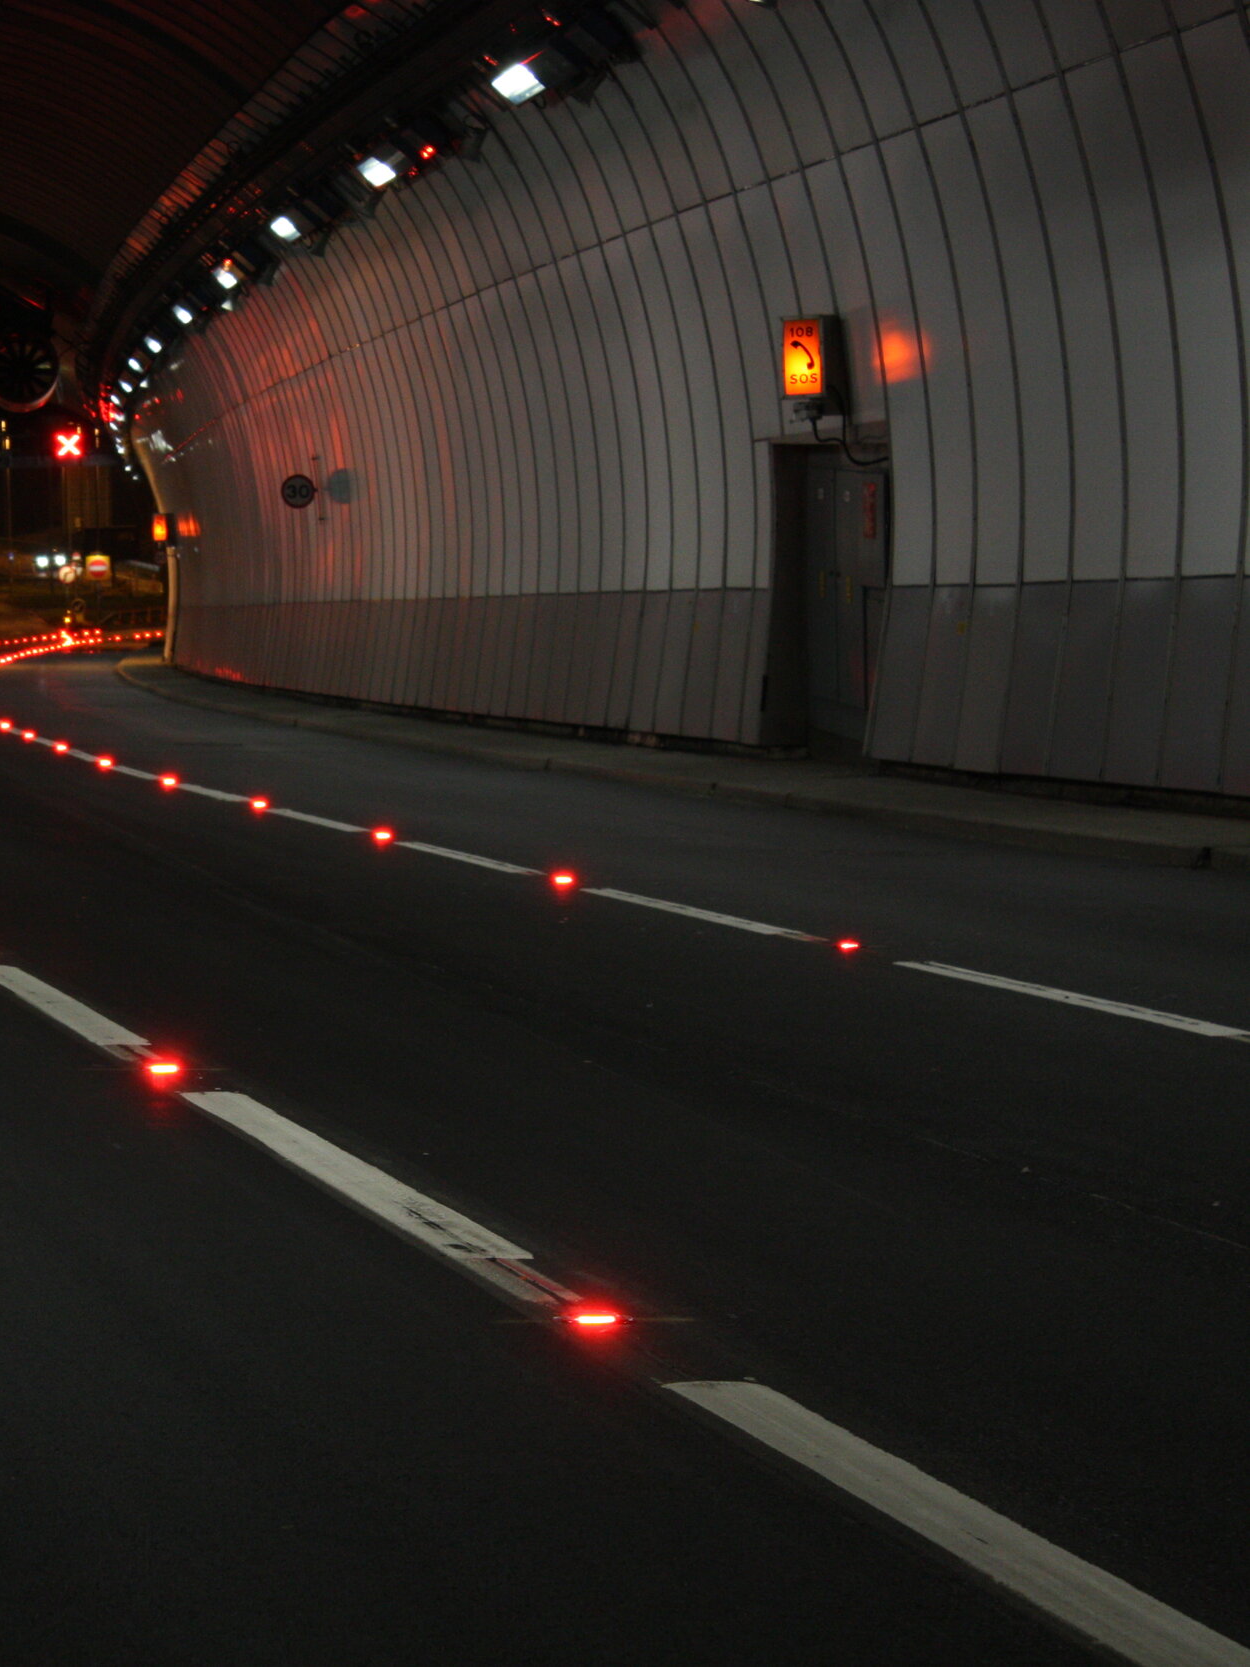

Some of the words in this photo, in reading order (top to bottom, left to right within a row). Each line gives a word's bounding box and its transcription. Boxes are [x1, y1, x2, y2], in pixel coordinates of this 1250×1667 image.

[789, 326, 814, 338] 108
[789, 373, 818, 385] SOS
[287, 484, 310, 499] 30
